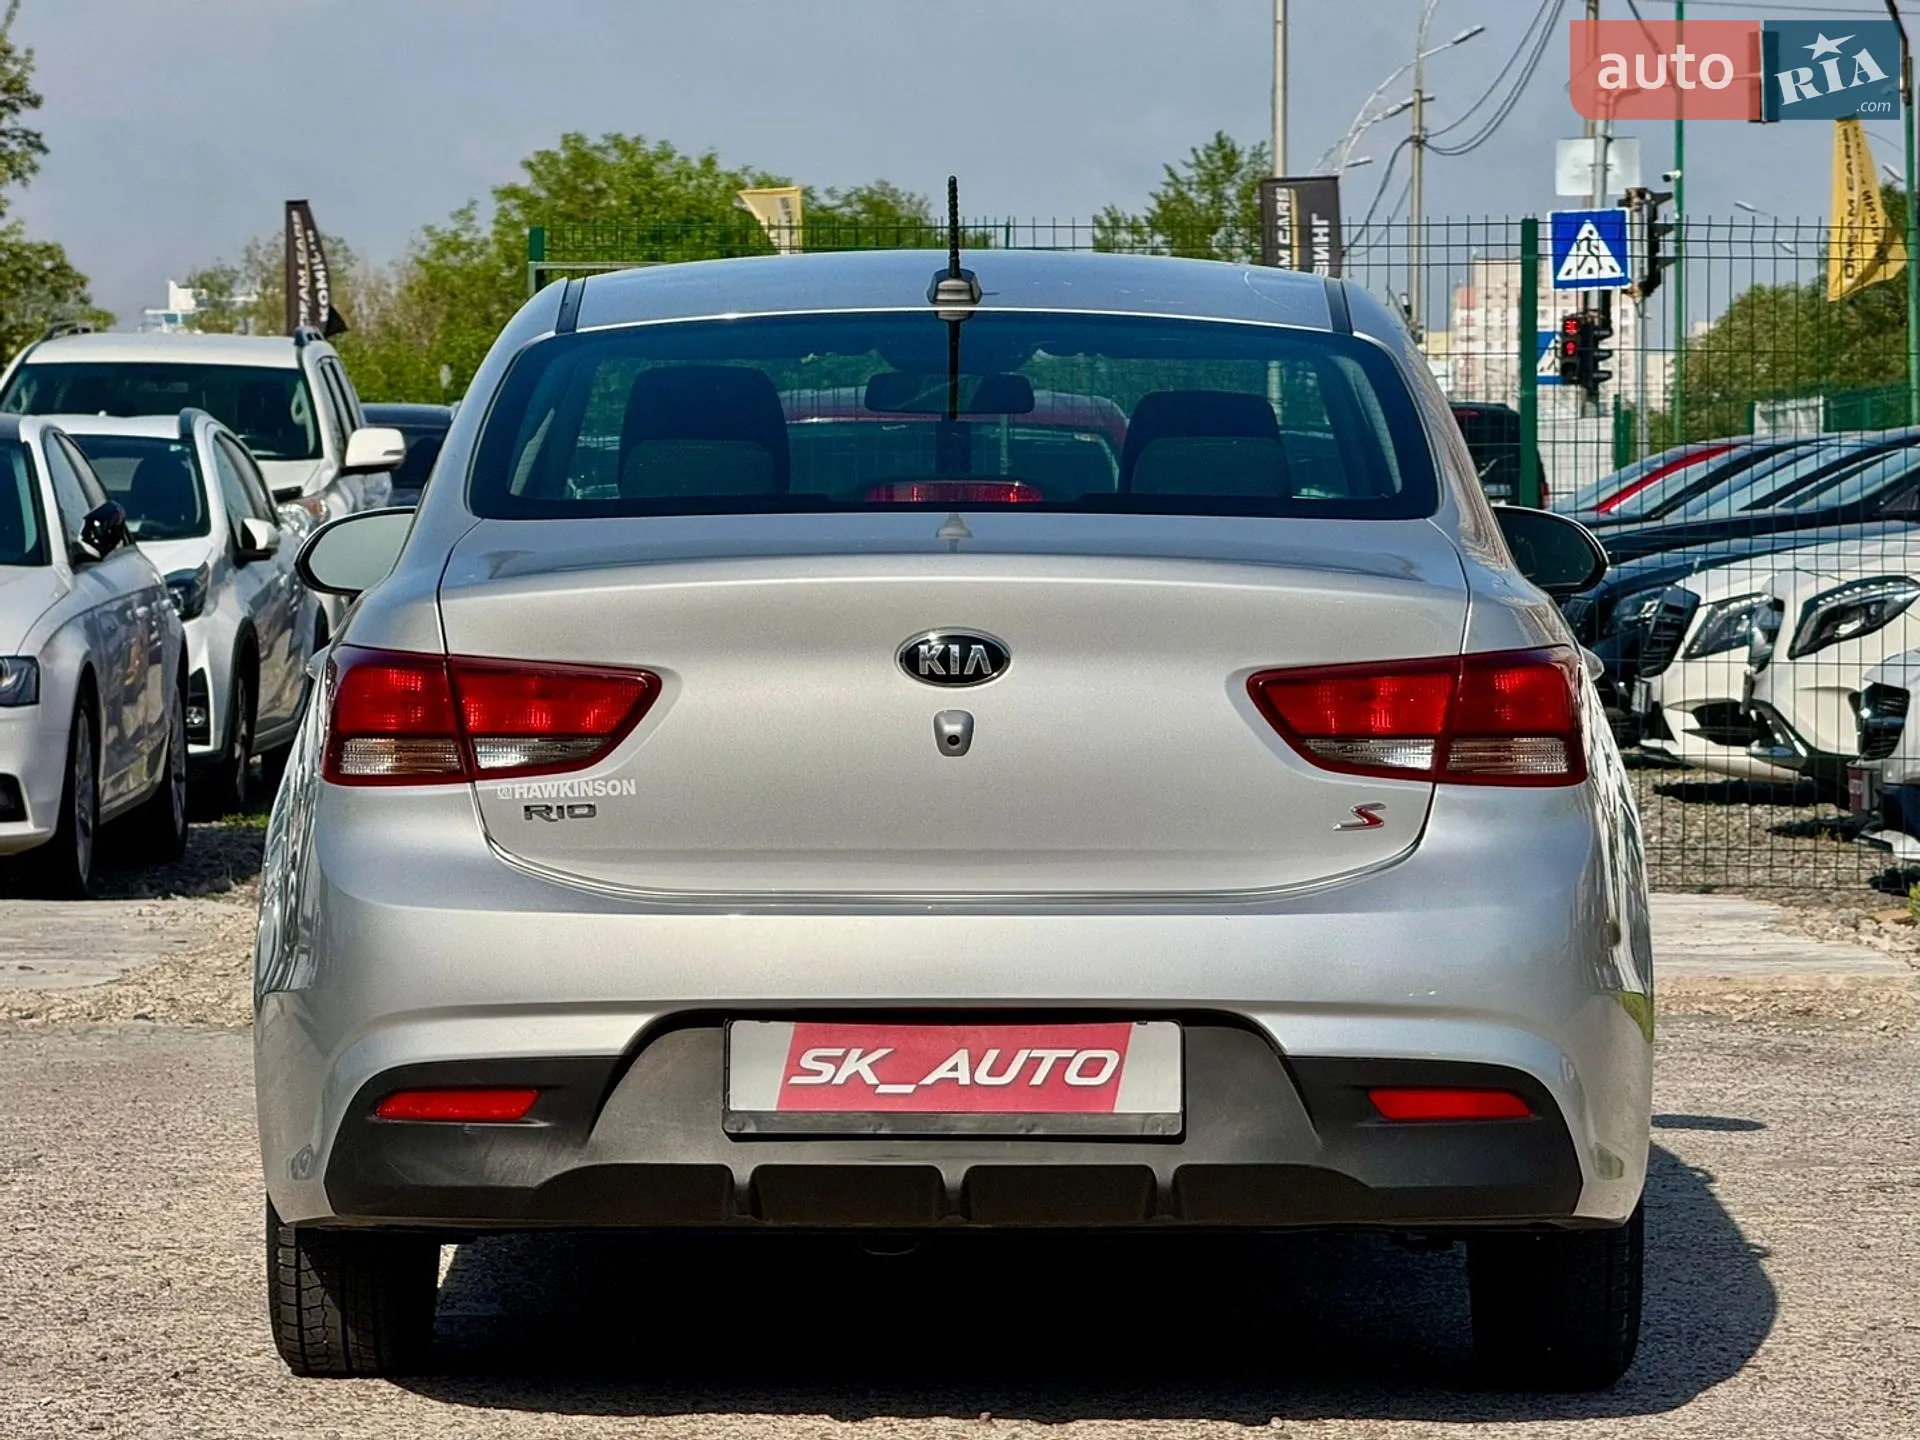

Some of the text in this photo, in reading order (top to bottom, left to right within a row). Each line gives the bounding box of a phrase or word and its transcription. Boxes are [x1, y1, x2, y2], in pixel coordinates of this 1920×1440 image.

[918, 644, 992, 675] KIA
[523, 804, 597, 822] RIO
[1333, 802, 1386, 831] S
[788, 1047, 1120, 1094] SK_AUTO
